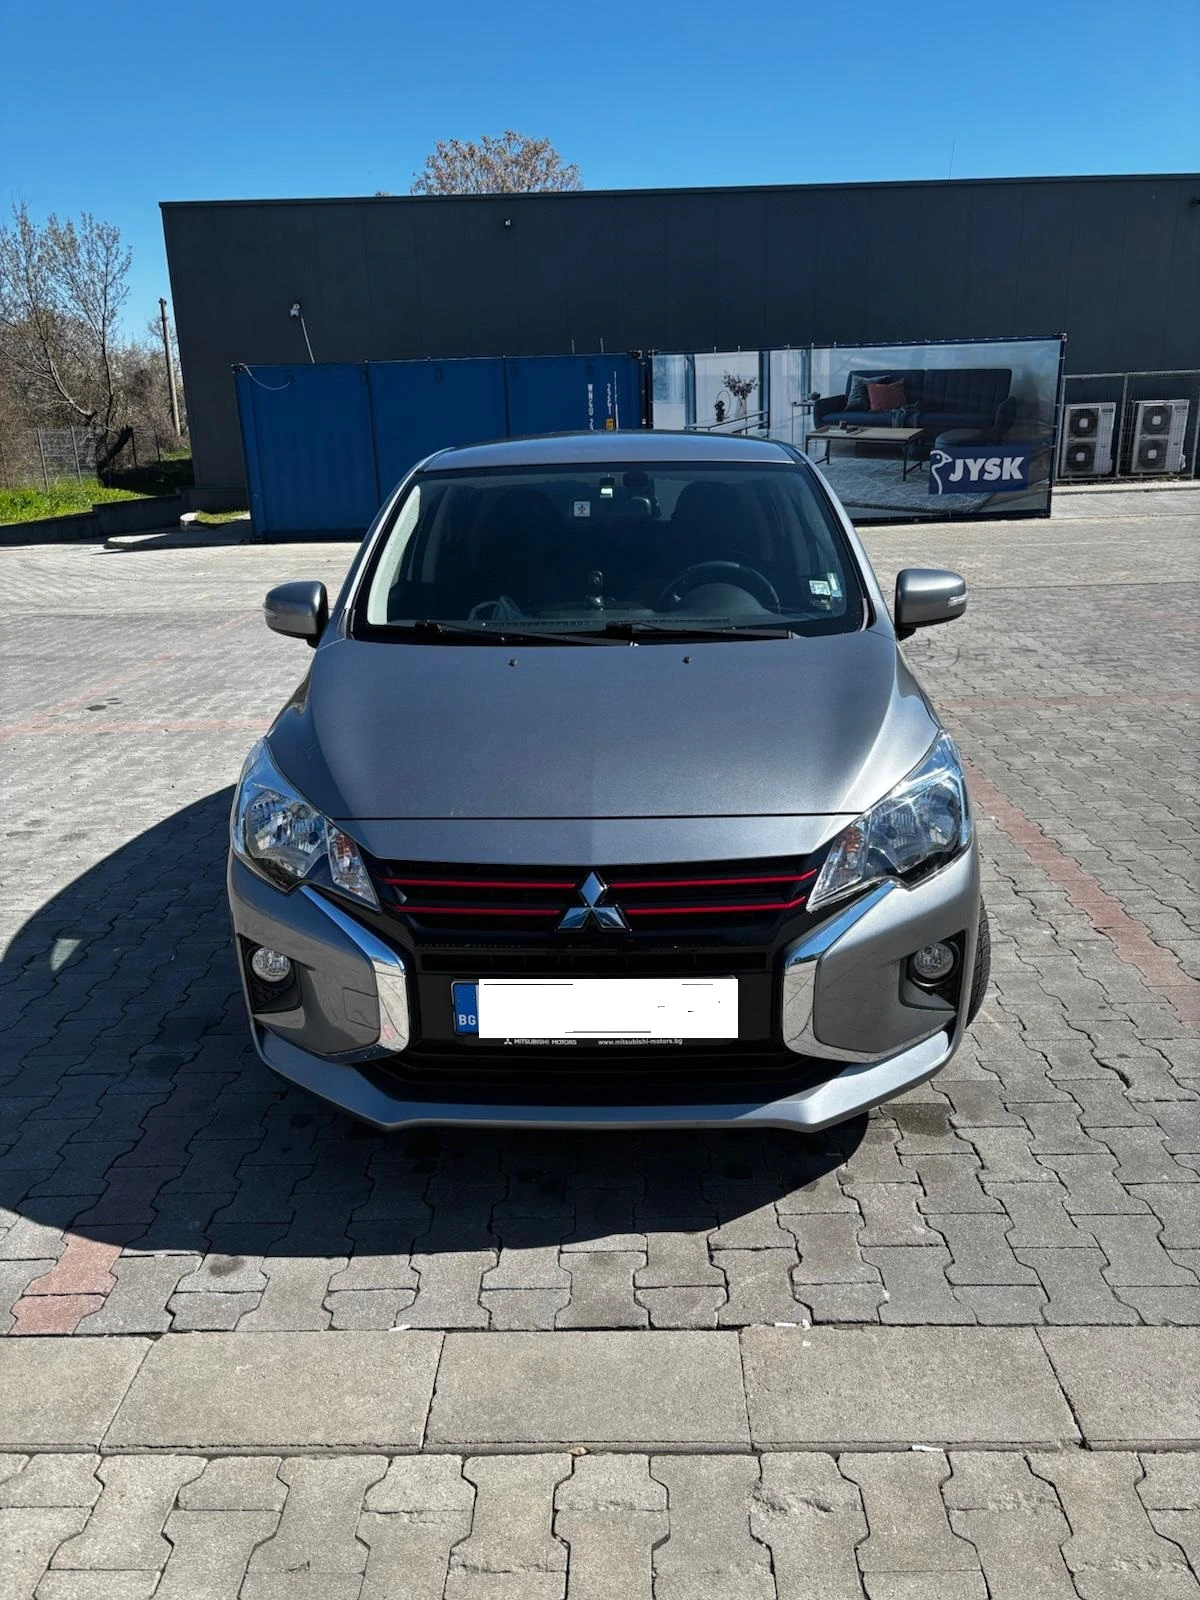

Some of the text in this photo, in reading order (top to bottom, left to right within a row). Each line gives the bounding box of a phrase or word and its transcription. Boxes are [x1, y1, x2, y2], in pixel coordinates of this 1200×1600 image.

[948, 456, 1025, 482] JYSK
[458, 1014, 477, 1026] BG
[551, 1038, 577, 1046] MOTORS
[597, 1037, 683, 1046] www.mitsubishi-motors.bg
